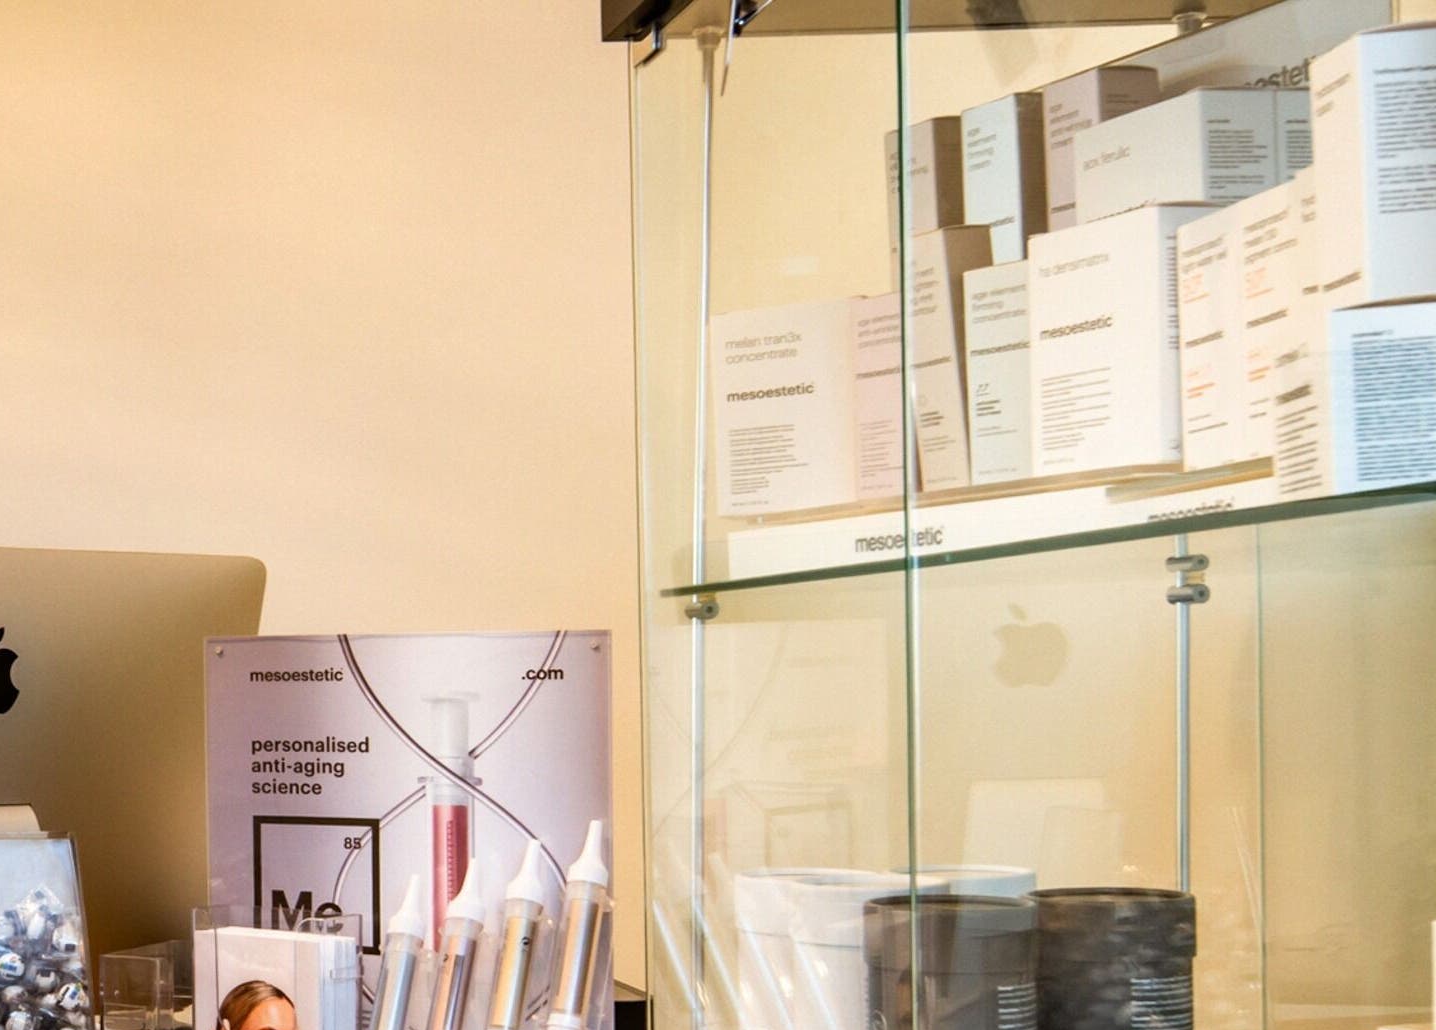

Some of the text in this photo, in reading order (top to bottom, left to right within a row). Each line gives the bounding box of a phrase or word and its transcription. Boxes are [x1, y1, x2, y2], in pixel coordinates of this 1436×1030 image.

[1039, 315, 1113, 340] mesoestetic
[725, 347, 798, 365] concentrate
[726, 382, 815, 403] mesoestetic
[855, 526, 945, 553] mesoetetic
[249, 667, 564, 682] mesoestetic .com
[251, 736, 369, 755] personalised
[251, 758, 345, 778] anti-aging
[251, 779, 322, 795] science
[344, 837, 362, 850] 85
[271, 889, 343, 934] Me
